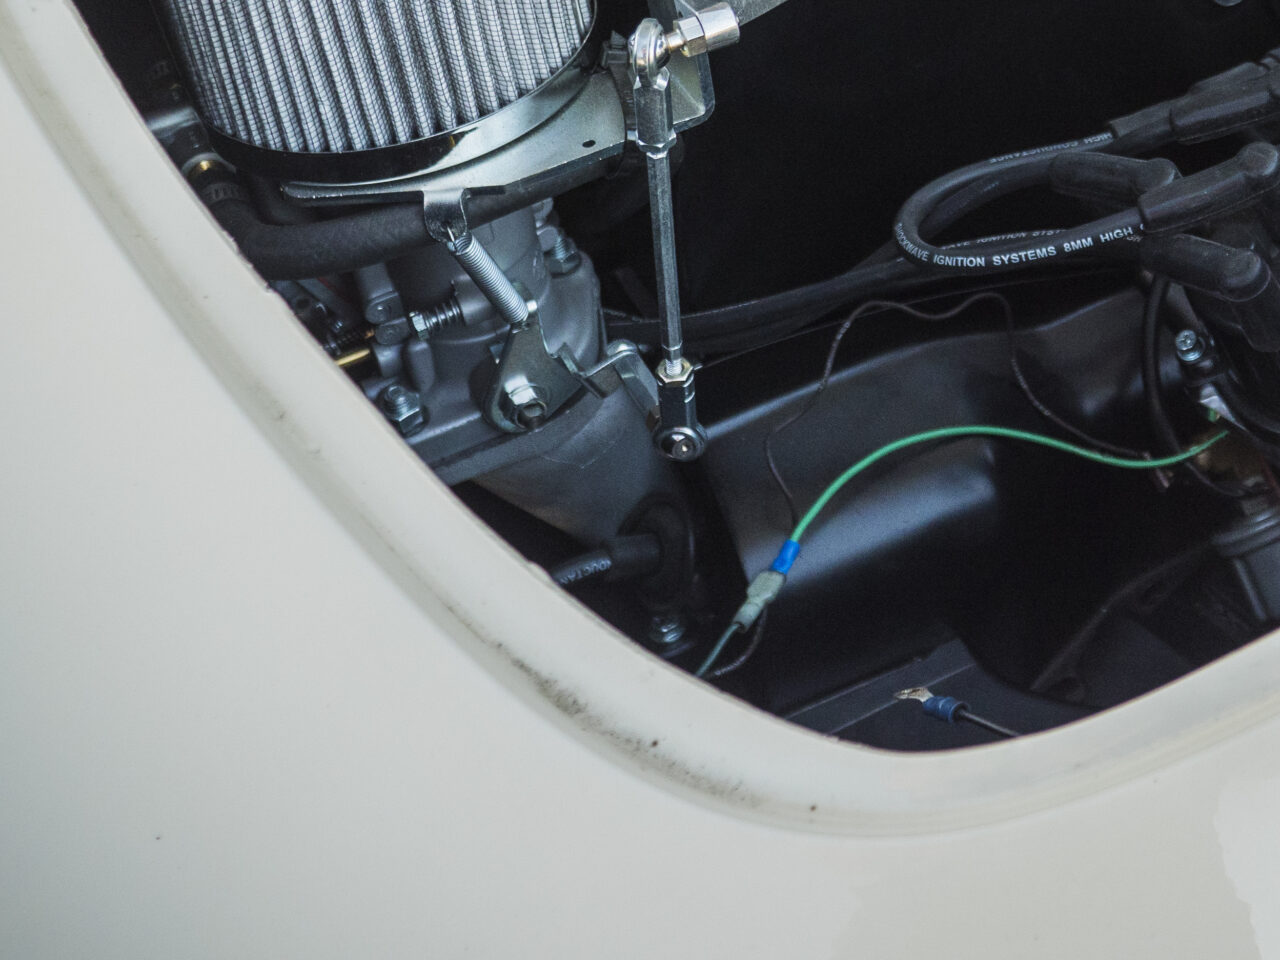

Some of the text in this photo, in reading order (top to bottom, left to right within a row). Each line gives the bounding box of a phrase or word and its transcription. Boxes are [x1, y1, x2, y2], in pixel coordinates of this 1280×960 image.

[933, 253, 986, 268] IGNITION
[993, 246, 1057, 267] SYSTEMS
[1063, 237, 1094, 253] 8MM
[1099, 226, 1134, 243] HIGH
